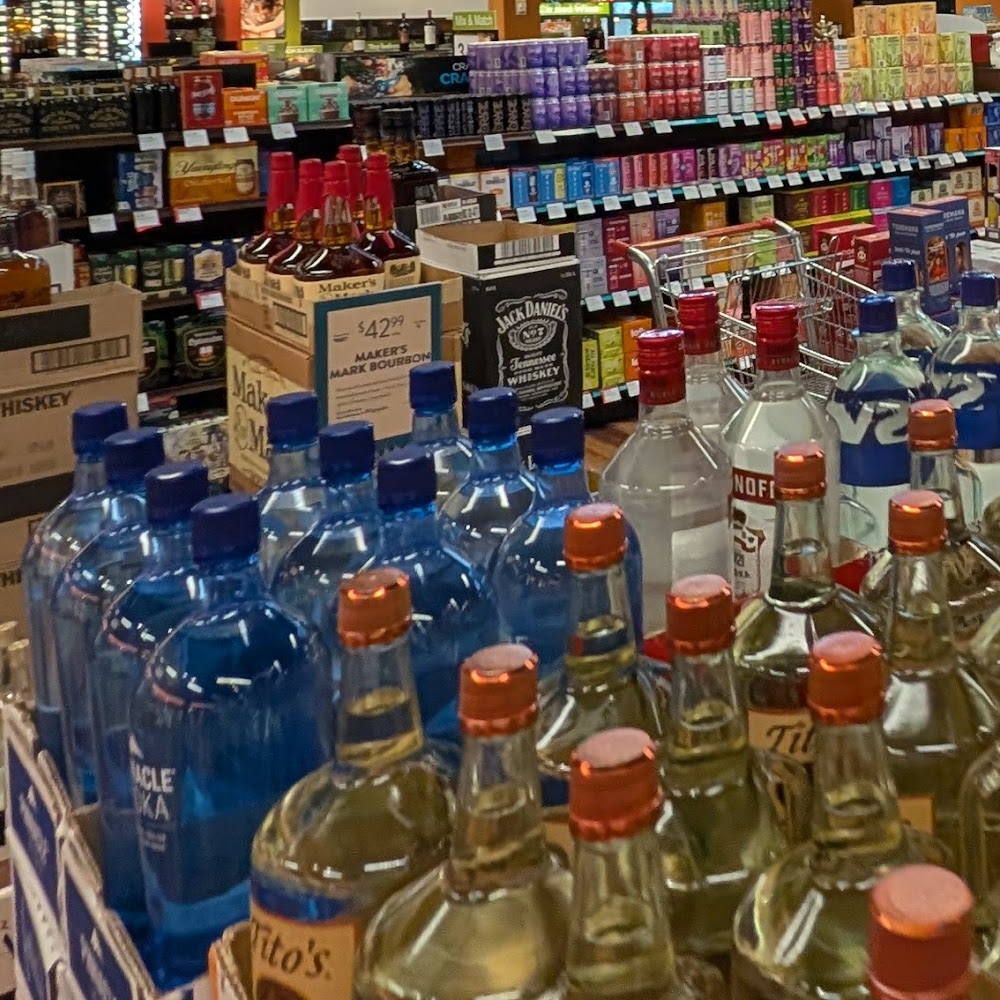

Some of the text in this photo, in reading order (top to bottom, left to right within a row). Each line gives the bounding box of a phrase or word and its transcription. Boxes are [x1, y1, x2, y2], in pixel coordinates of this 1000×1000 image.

[317, 278, 377, 294] Maker's
[494, 299, 570, 335] JACK DANIEL'S
[329, 350, 430, 380] MARK BOURBON
[354, 344, 409, 364] MAKER'S
[509, 353, 557, 372] Tennessee
[506, 365, 560, 386] WHISKEY
[0, 391, 73, 417] HISKEY
[252, 921, 331, 979] Tito's
